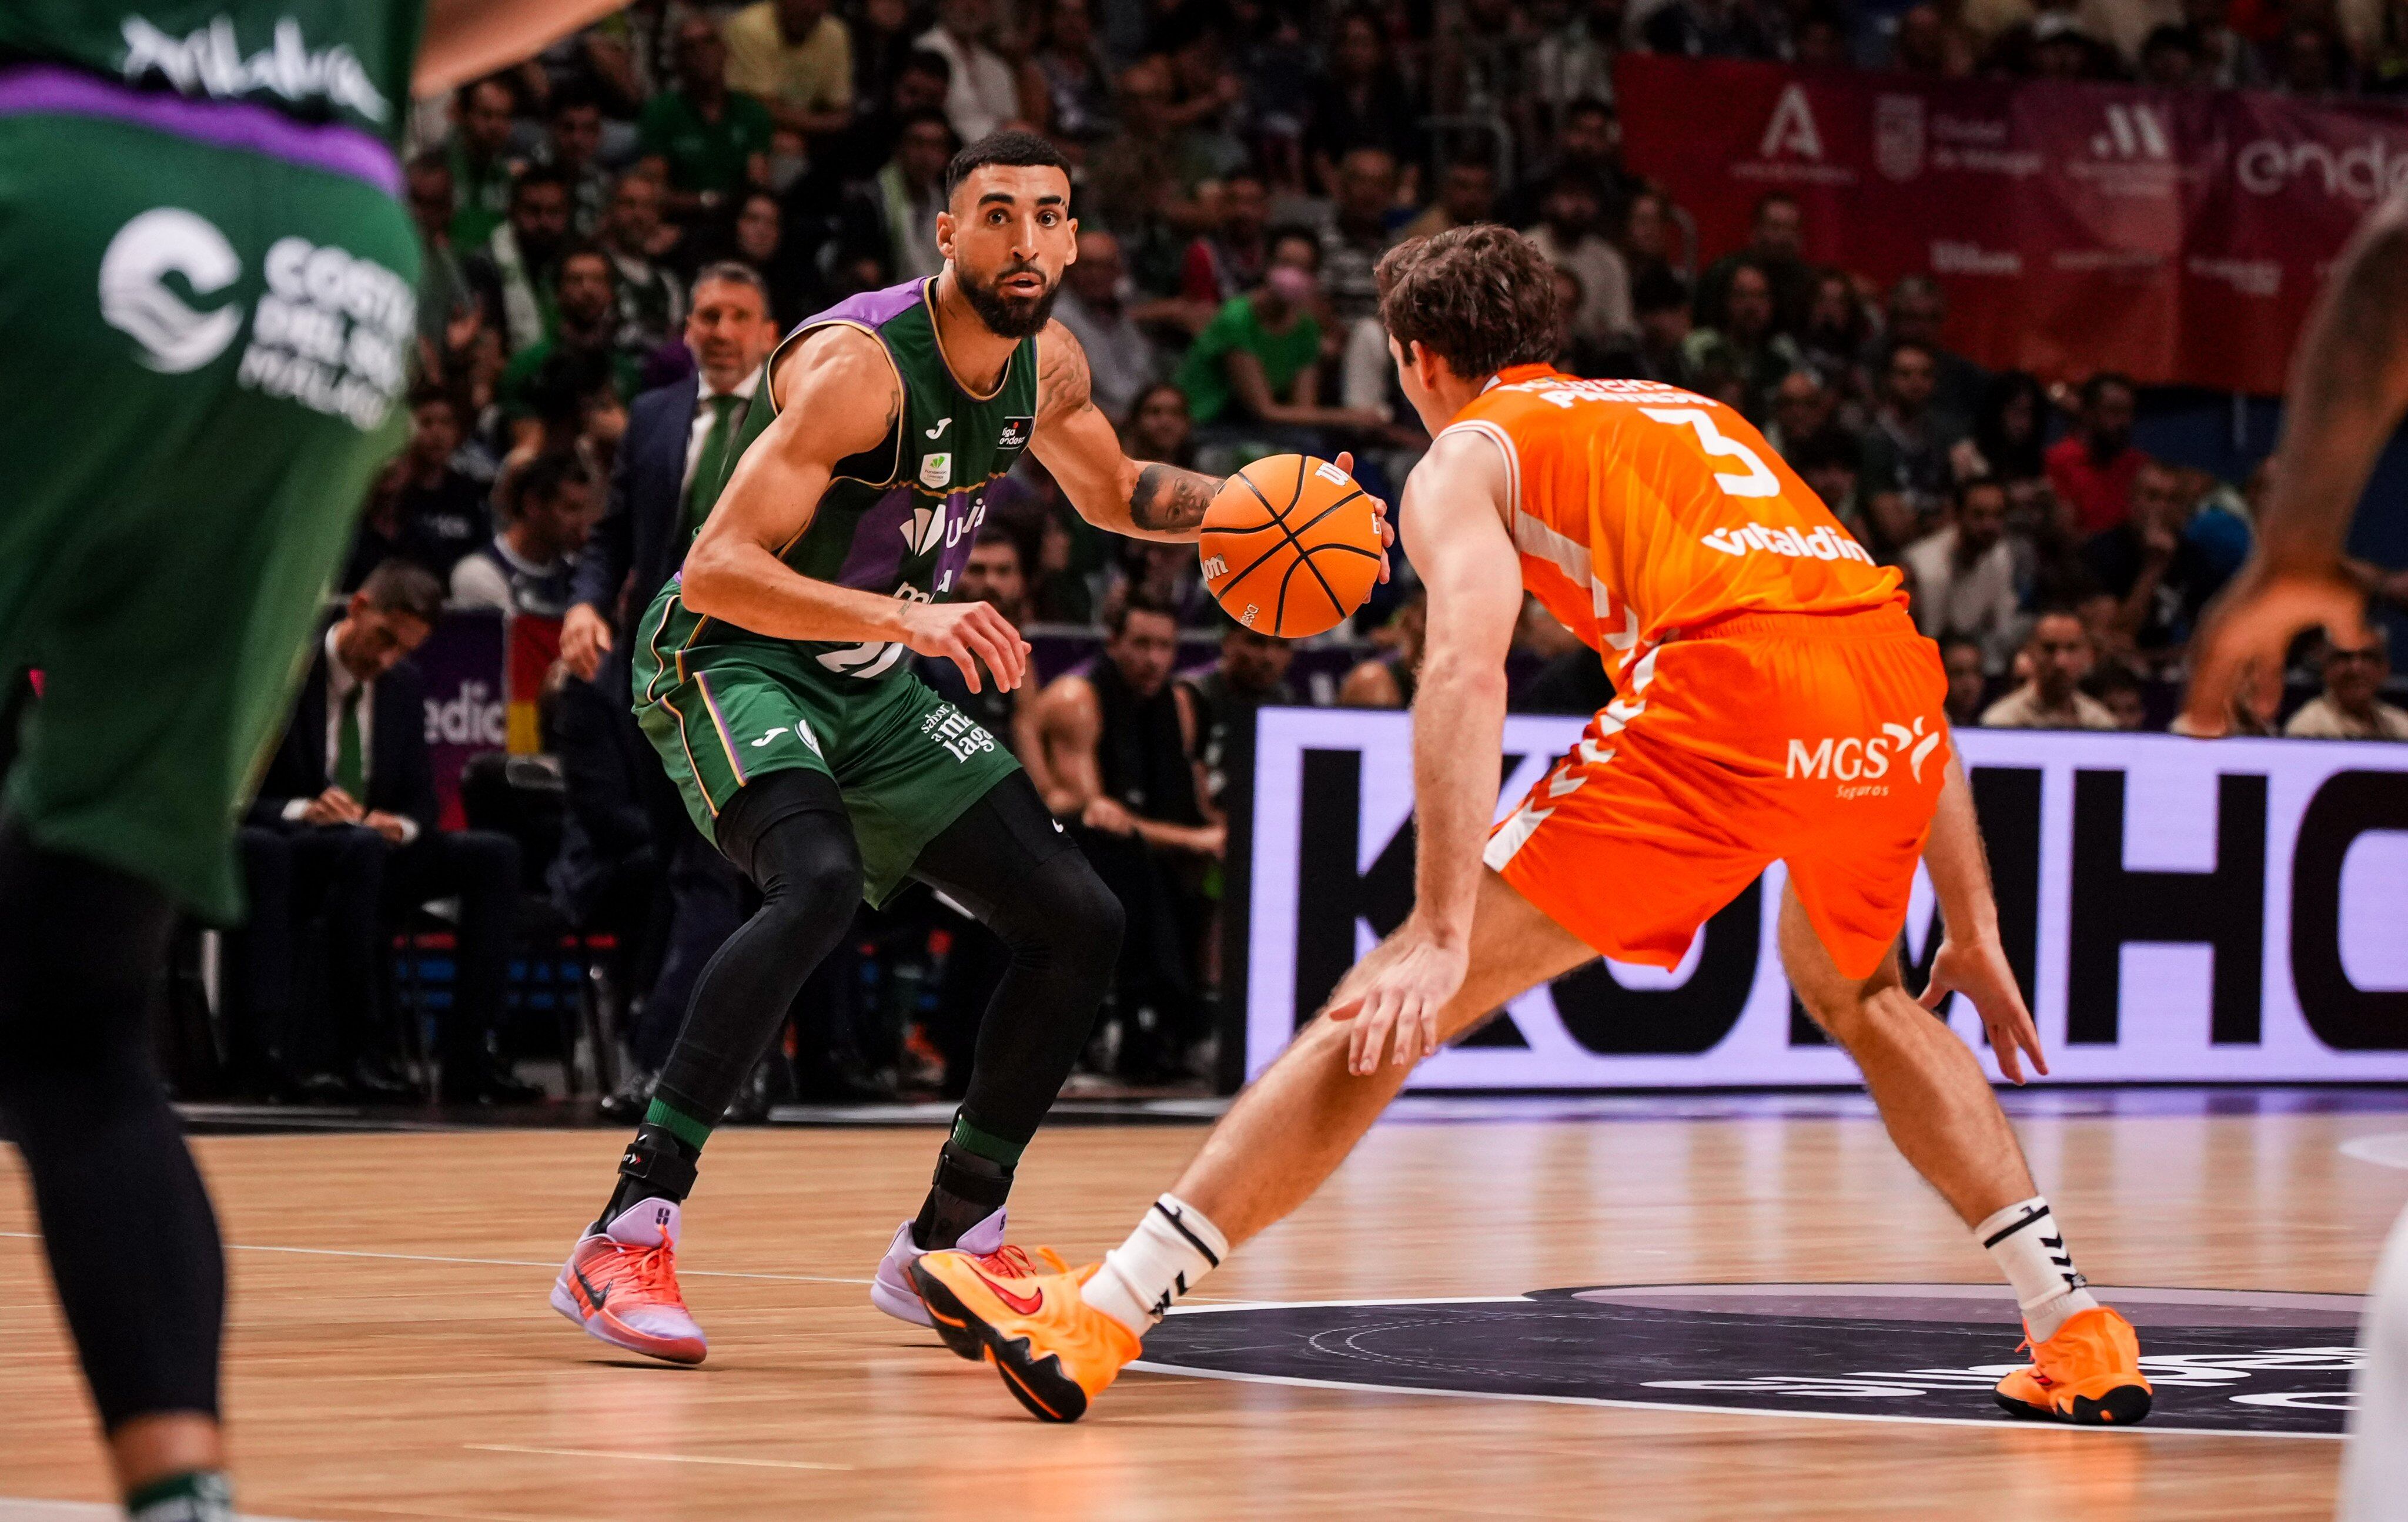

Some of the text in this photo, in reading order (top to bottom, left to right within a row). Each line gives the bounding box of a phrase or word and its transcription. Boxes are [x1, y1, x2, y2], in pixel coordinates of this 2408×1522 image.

[1638, 407, 1780, 497] 3
[921, 704, 950, 734] sabor
[931, 733, 944, 742] a
[1785, 737, 1889, 781] MGS
[1836, 785, 1888, 800] Seguros
